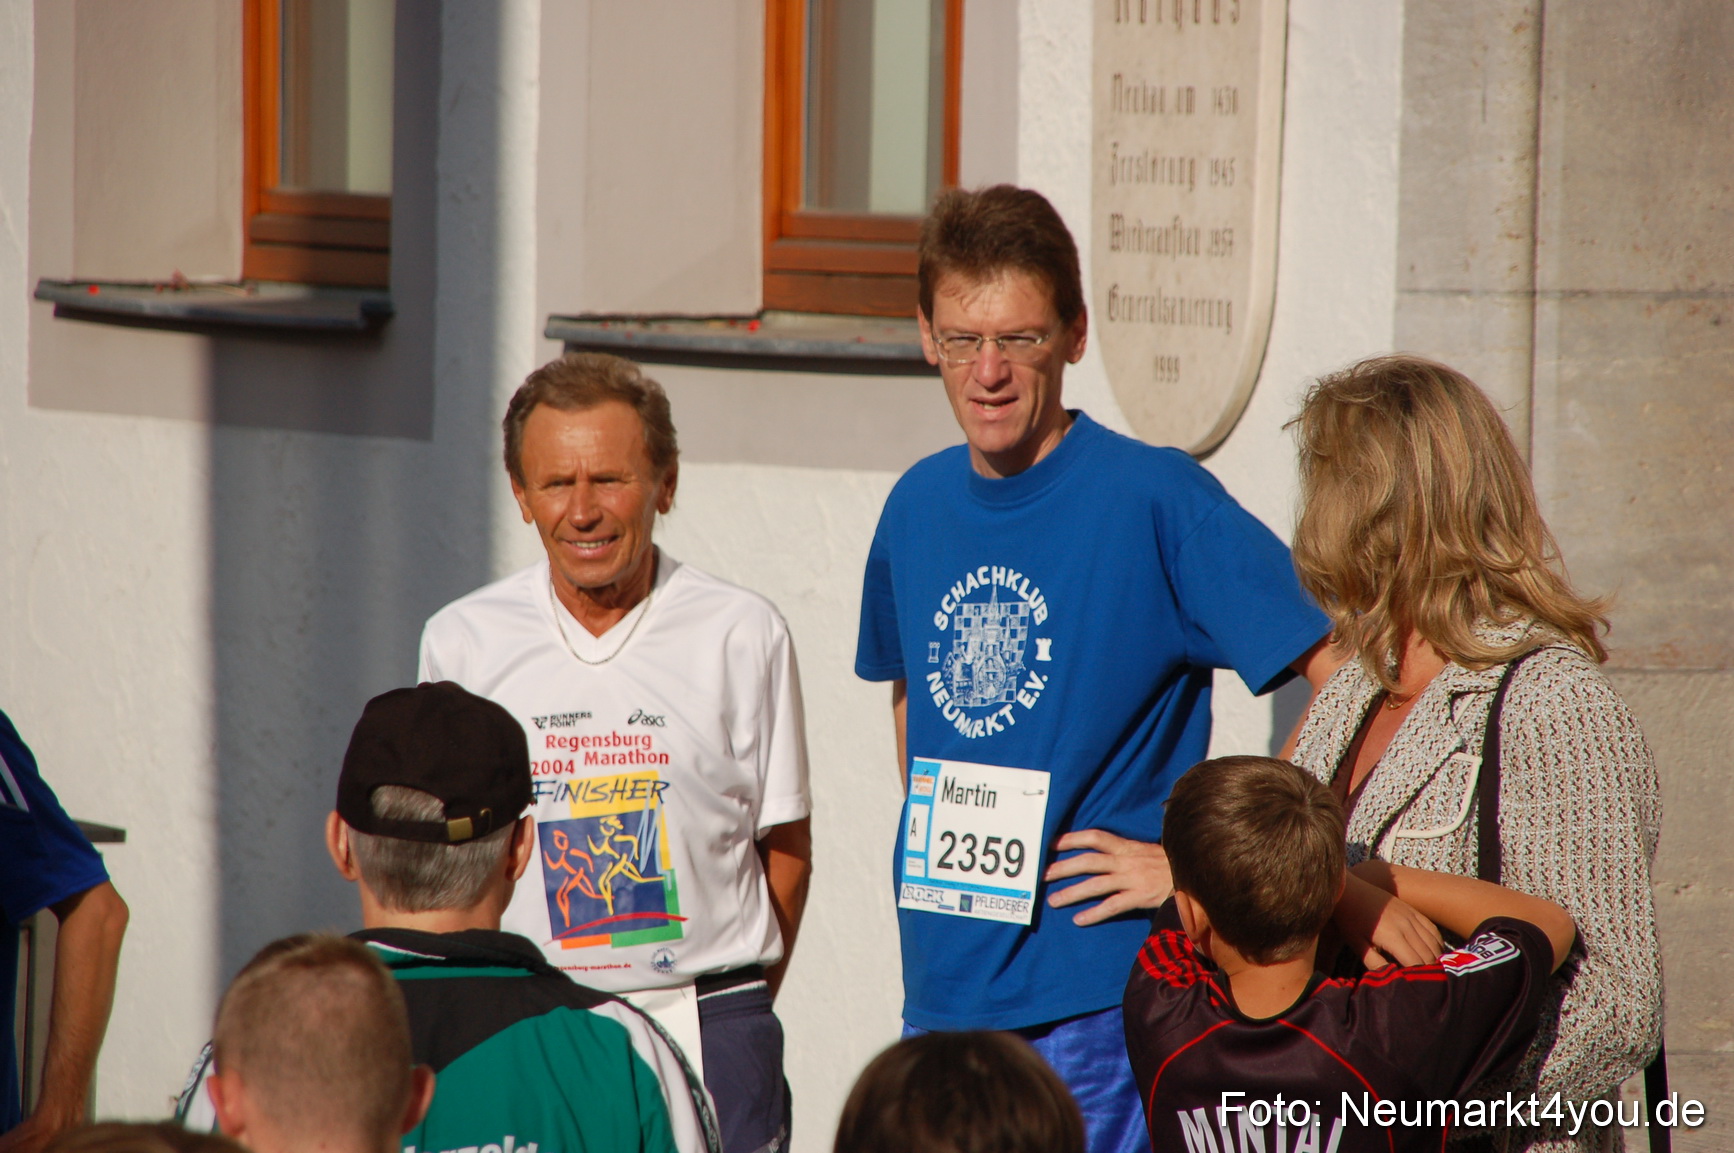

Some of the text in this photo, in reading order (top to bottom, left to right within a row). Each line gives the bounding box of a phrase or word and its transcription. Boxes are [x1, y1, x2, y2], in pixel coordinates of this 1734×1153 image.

[933, 565, 1048, 632] SCHACHKLUB
[550, 711, 593, 720] RUNNERS
[550, 720, 577, 728] POINT
[545, 730, 653, 753] Regensburg
[530, 748, 670, 776] 2004 Marathon
[532, 778, 671, 806] FINISHER
[941, 775, 998, 809] Martin
[910, 817, 917, 837] A
[936, 830, 1026, 878] 2359
[975, 895, 1030, 913] PFLEIDERER
